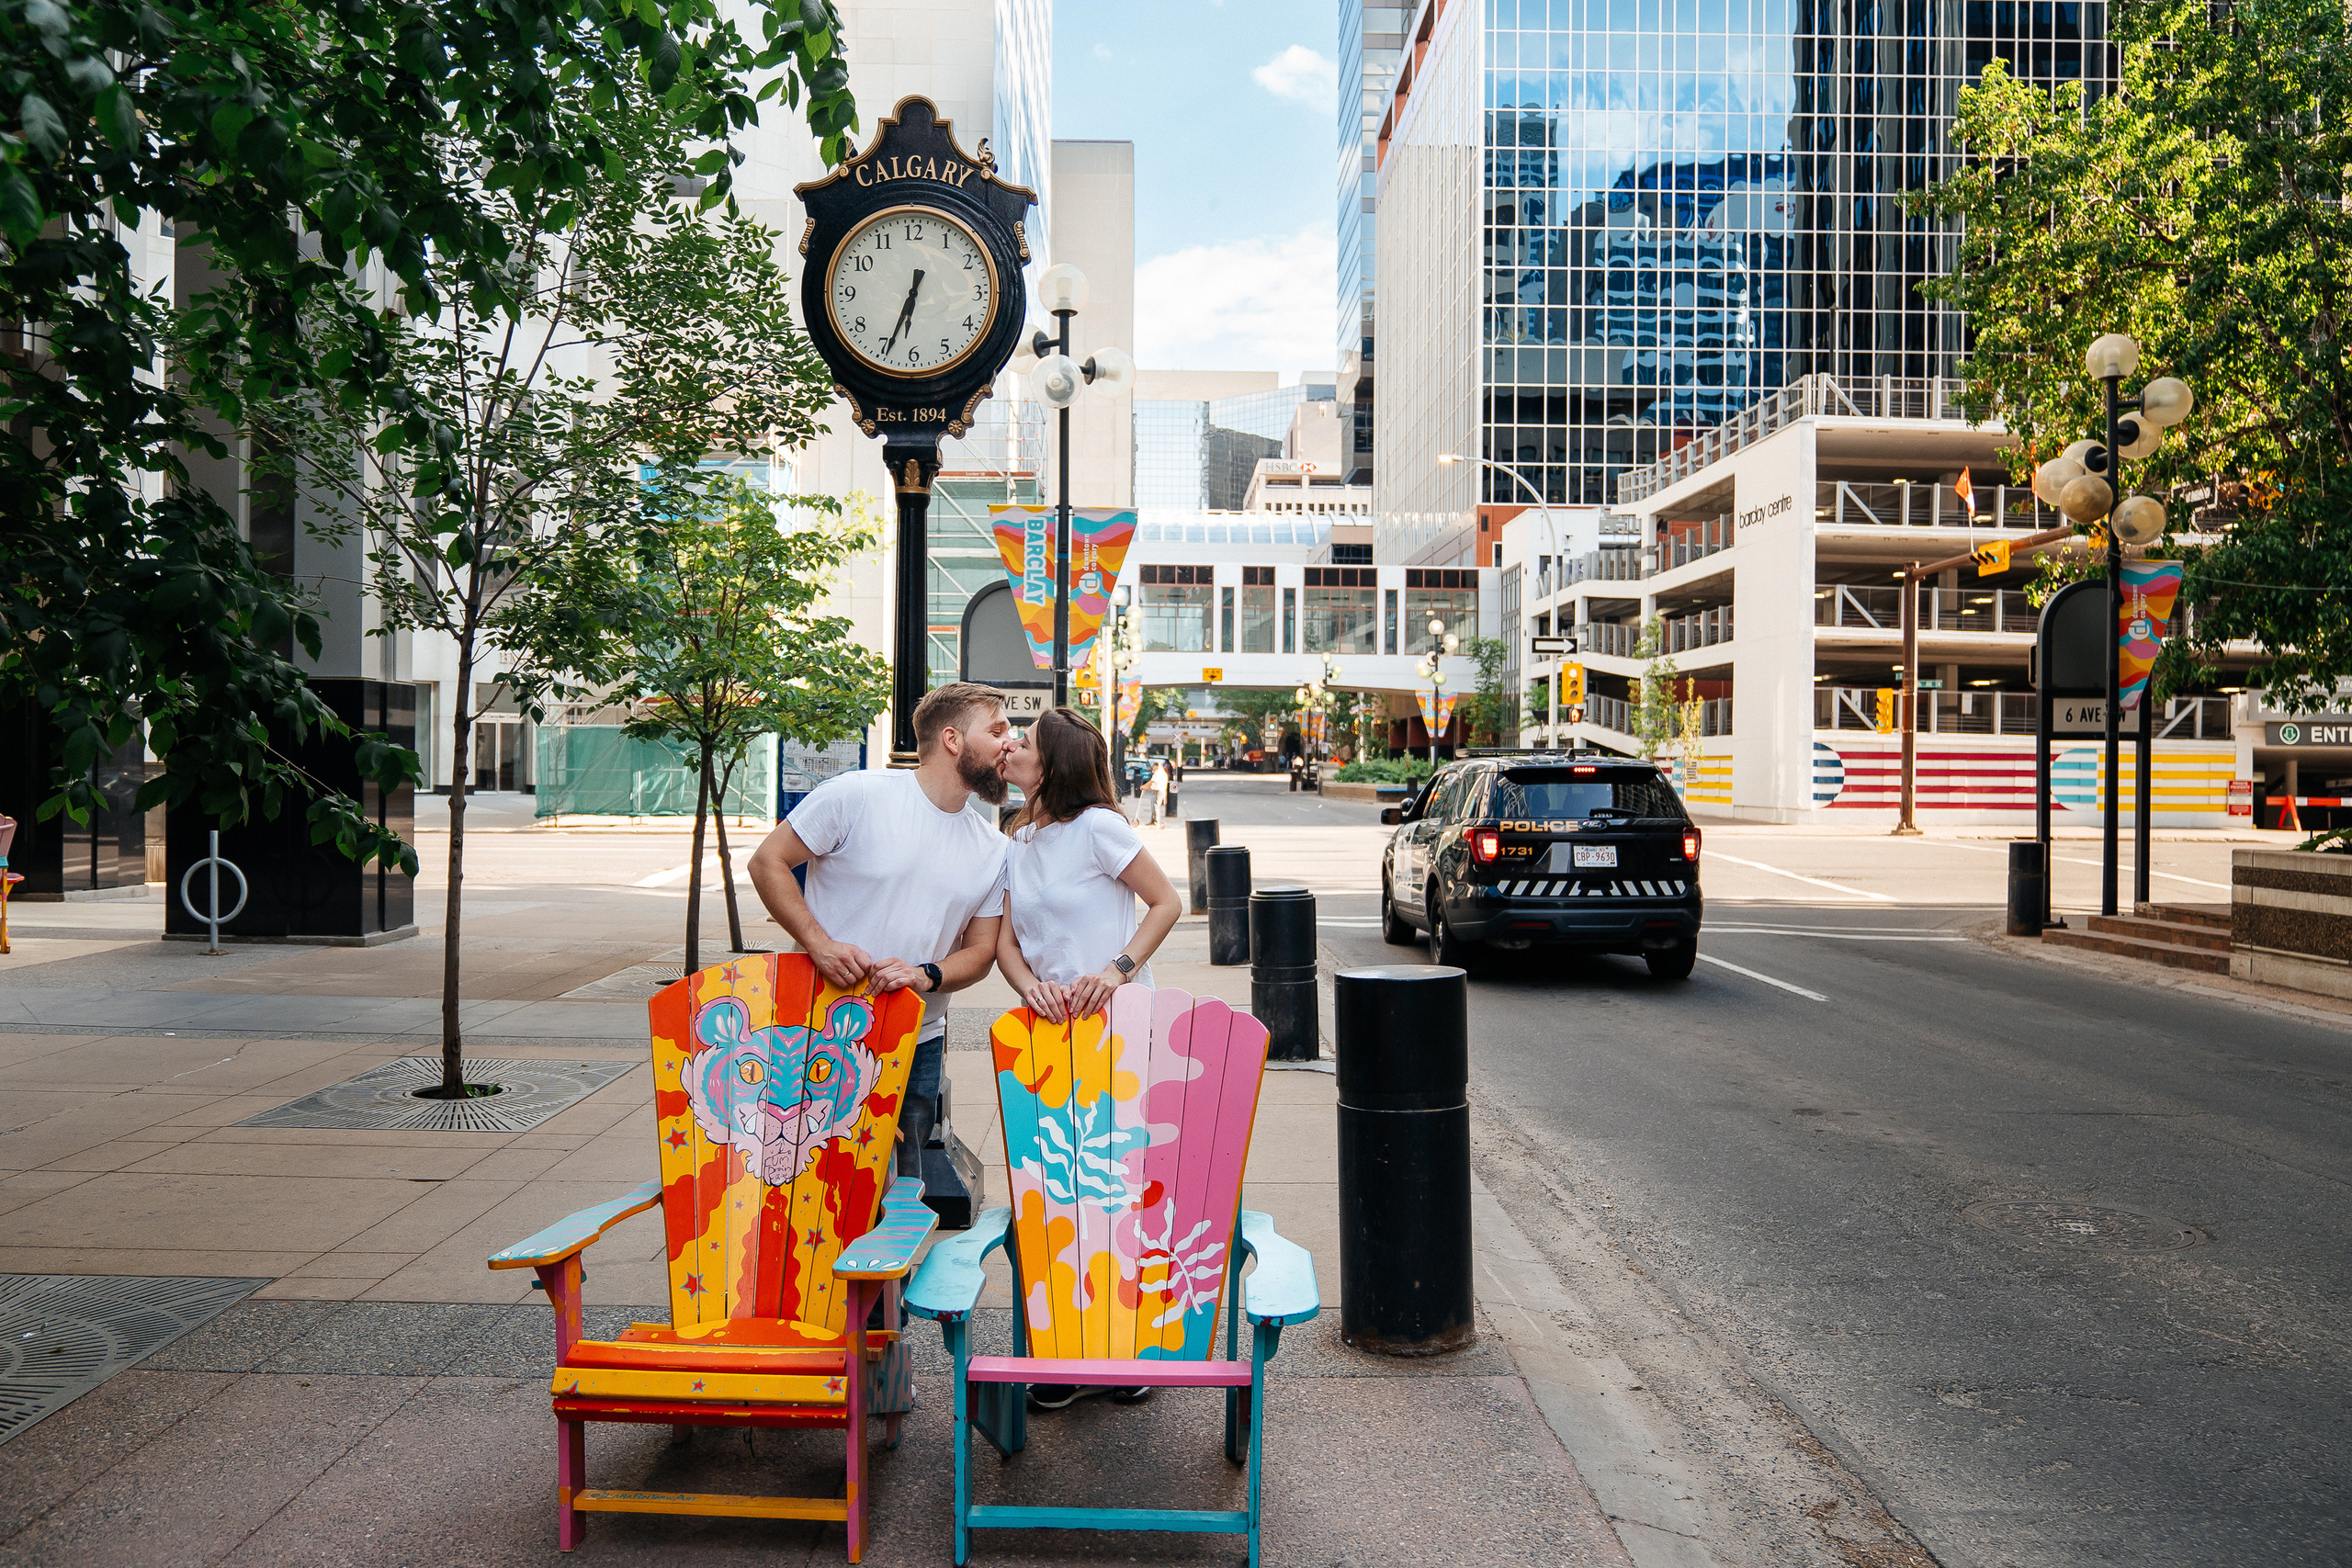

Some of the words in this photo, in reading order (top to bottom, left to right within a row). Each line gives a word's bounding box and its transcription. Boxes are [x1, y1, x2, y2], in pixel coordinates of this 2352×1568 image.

[855, 154, 975, 188] CALGARY
[875, 232, 892, 250] 11
[904, 224, 923, 241] 12
[942, 232, 950, 249] 1
[854, 254, 874, 272] 10
[962, 254, 974, 270] 2
[844, 286, 856, 302] 9
[971, 285, 983, 301] 3
[854, 316, 866, 333] 8
[961, 314, 974, 332] 4
[877, 337, 889, 355] 7
[908, 345, 920, 362] 6
[939, 338, 950, 355] 5
[876, 407, 907, 422] Est.
[911, 407, 946, 423] 1894
[1265, 462, 1297, 473] HSBC
[1767, 493, 1792, 517] centre
[1023, 518, 1046, 605] BARCLAY
[1090, 543, 1099, 571] calgary
[2139, 592, 2148, 619] calgary
[1004, 696, 1018, 710] VE
[1023, 696, 1041, 710] SW
[2064, 706, 2074, 723] 6
[2079, 706, 2102, 723] AVE
[1499, 820, 1579, 832] POLICE
[1500, 847, 1532, 856] 1731
[1576, 852, 1615, 862] CBP-9630
